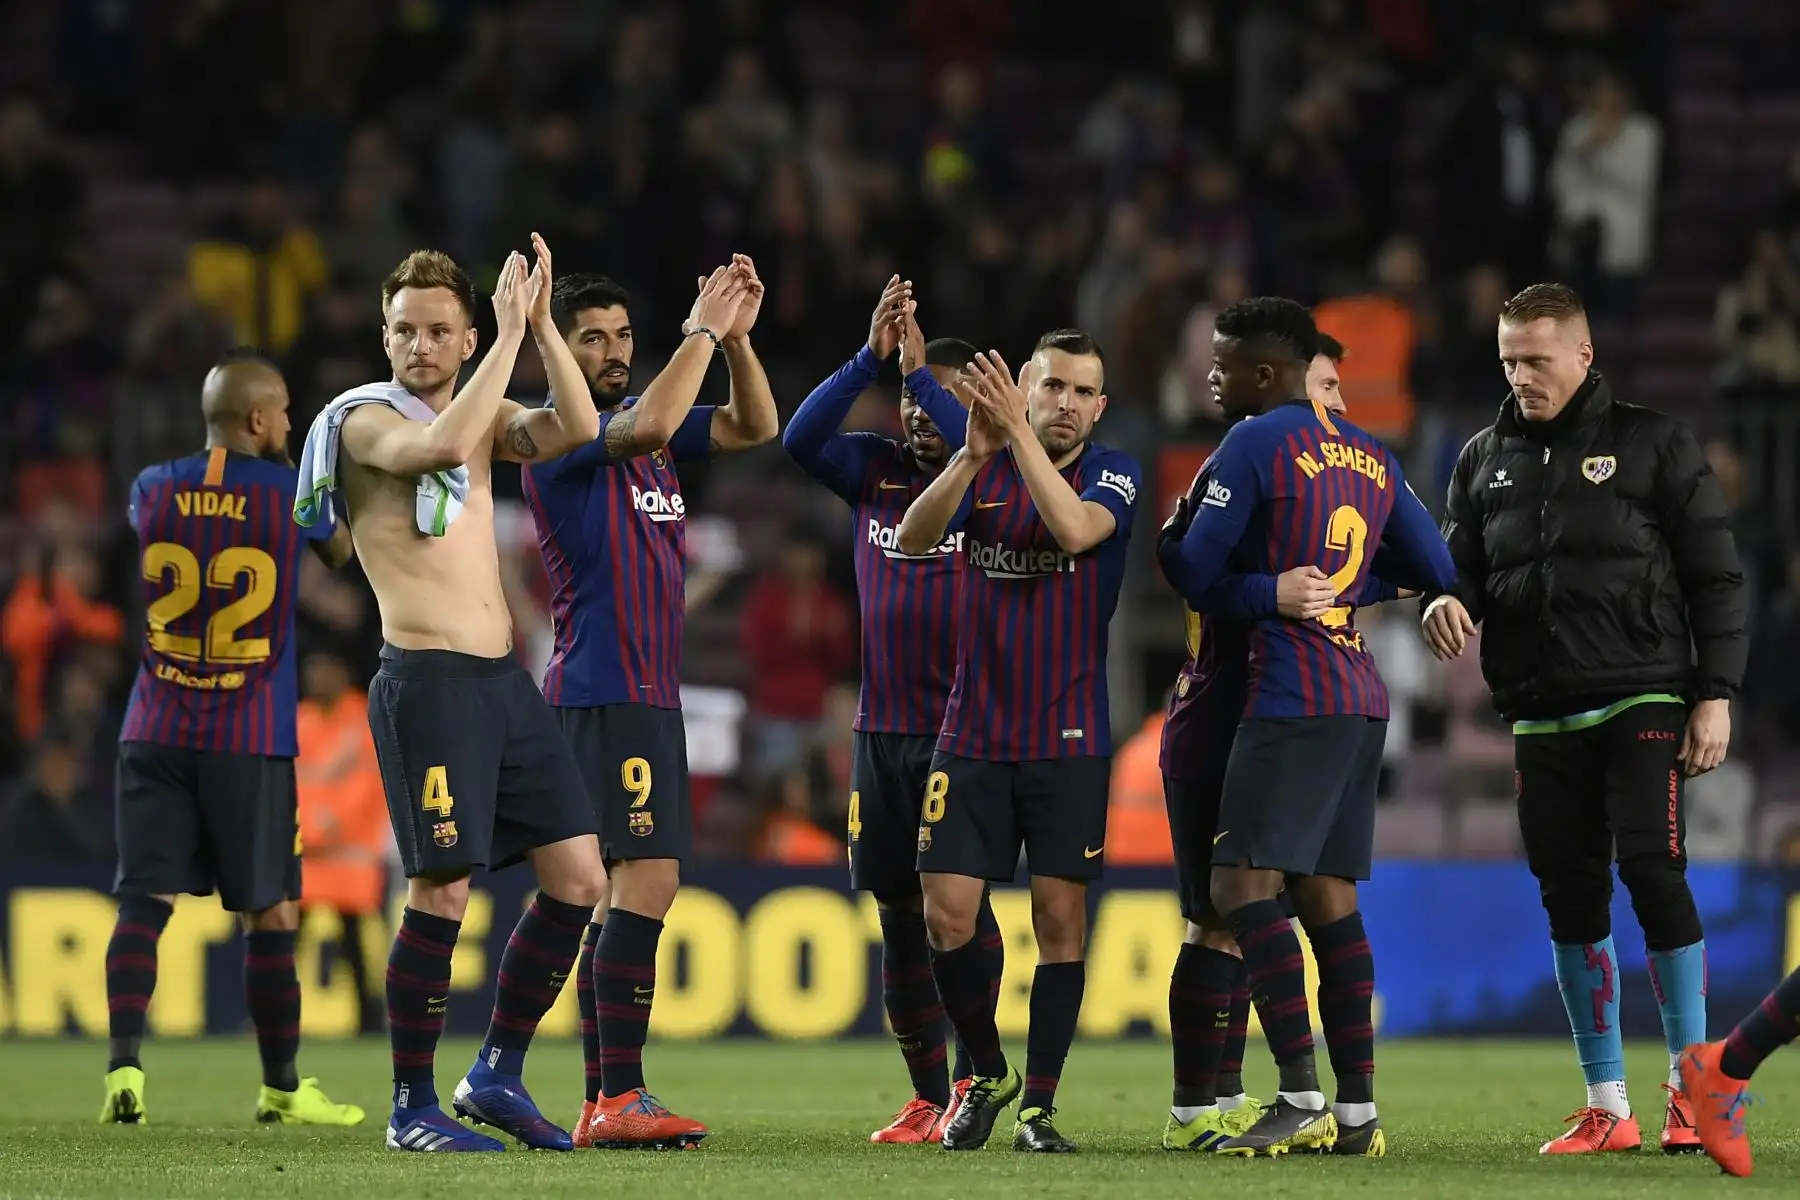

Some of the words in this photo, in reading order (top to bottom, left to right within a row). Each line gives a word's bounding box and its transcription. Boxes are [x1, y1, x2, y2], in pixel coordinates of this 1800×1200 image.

[1101, 469, 1136, 502] beko
[1295, 451, 1324, 479] N.
[1320, 441, 1386, 490] SEMEDO
[175, 492, 247, 521] VIDAL
[970, 540, 1075, 573] Rakuten
[143, 541, 277, 664] 22
[421, 765, 454, 818] 4
[621, 757, 652, 808] 9
[923, 771, 950, 823] 8
